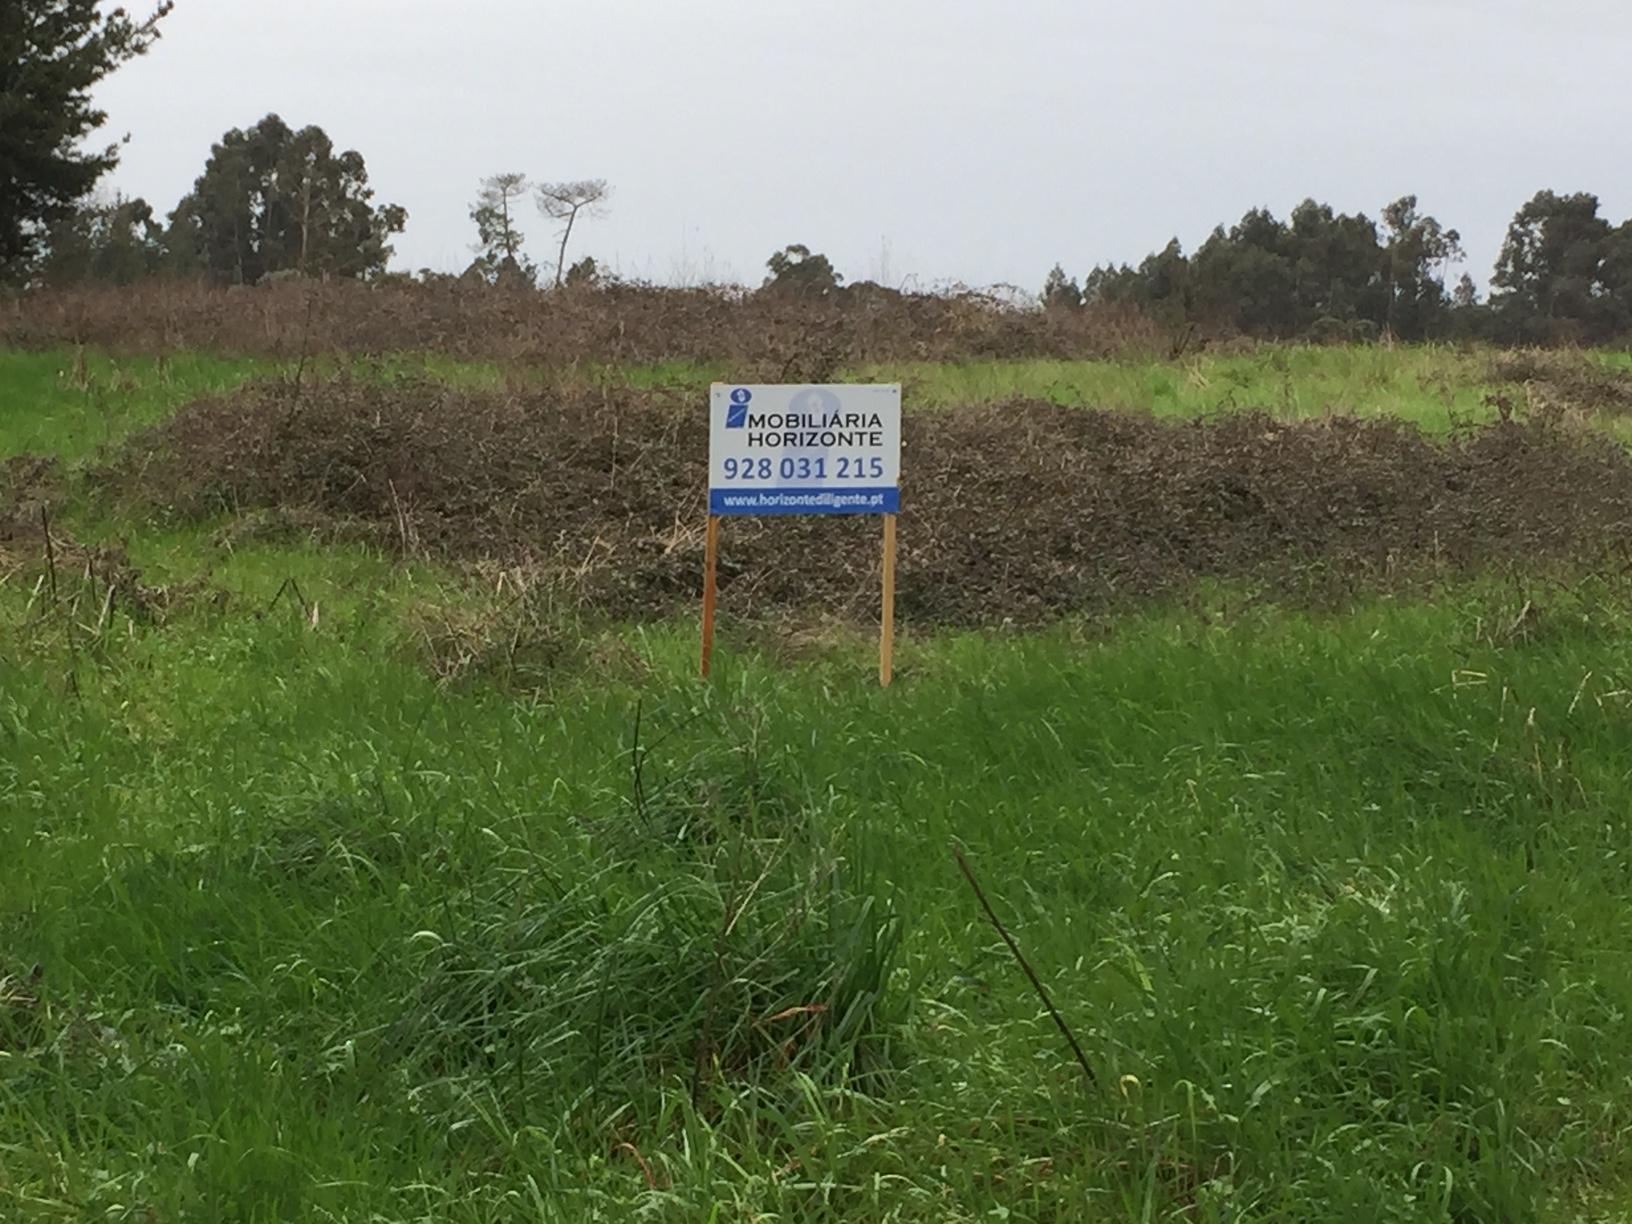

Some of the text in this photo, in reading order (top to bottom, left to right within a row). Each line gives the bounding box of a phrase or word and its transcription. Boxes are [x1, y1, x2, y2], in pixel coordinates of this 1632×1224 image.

[748, 431, 883, 447] HORIZONTE
[723, 456, 883, 480] 928 031 215
[723, 493, 883, 507] www.horizontediligente.pt
